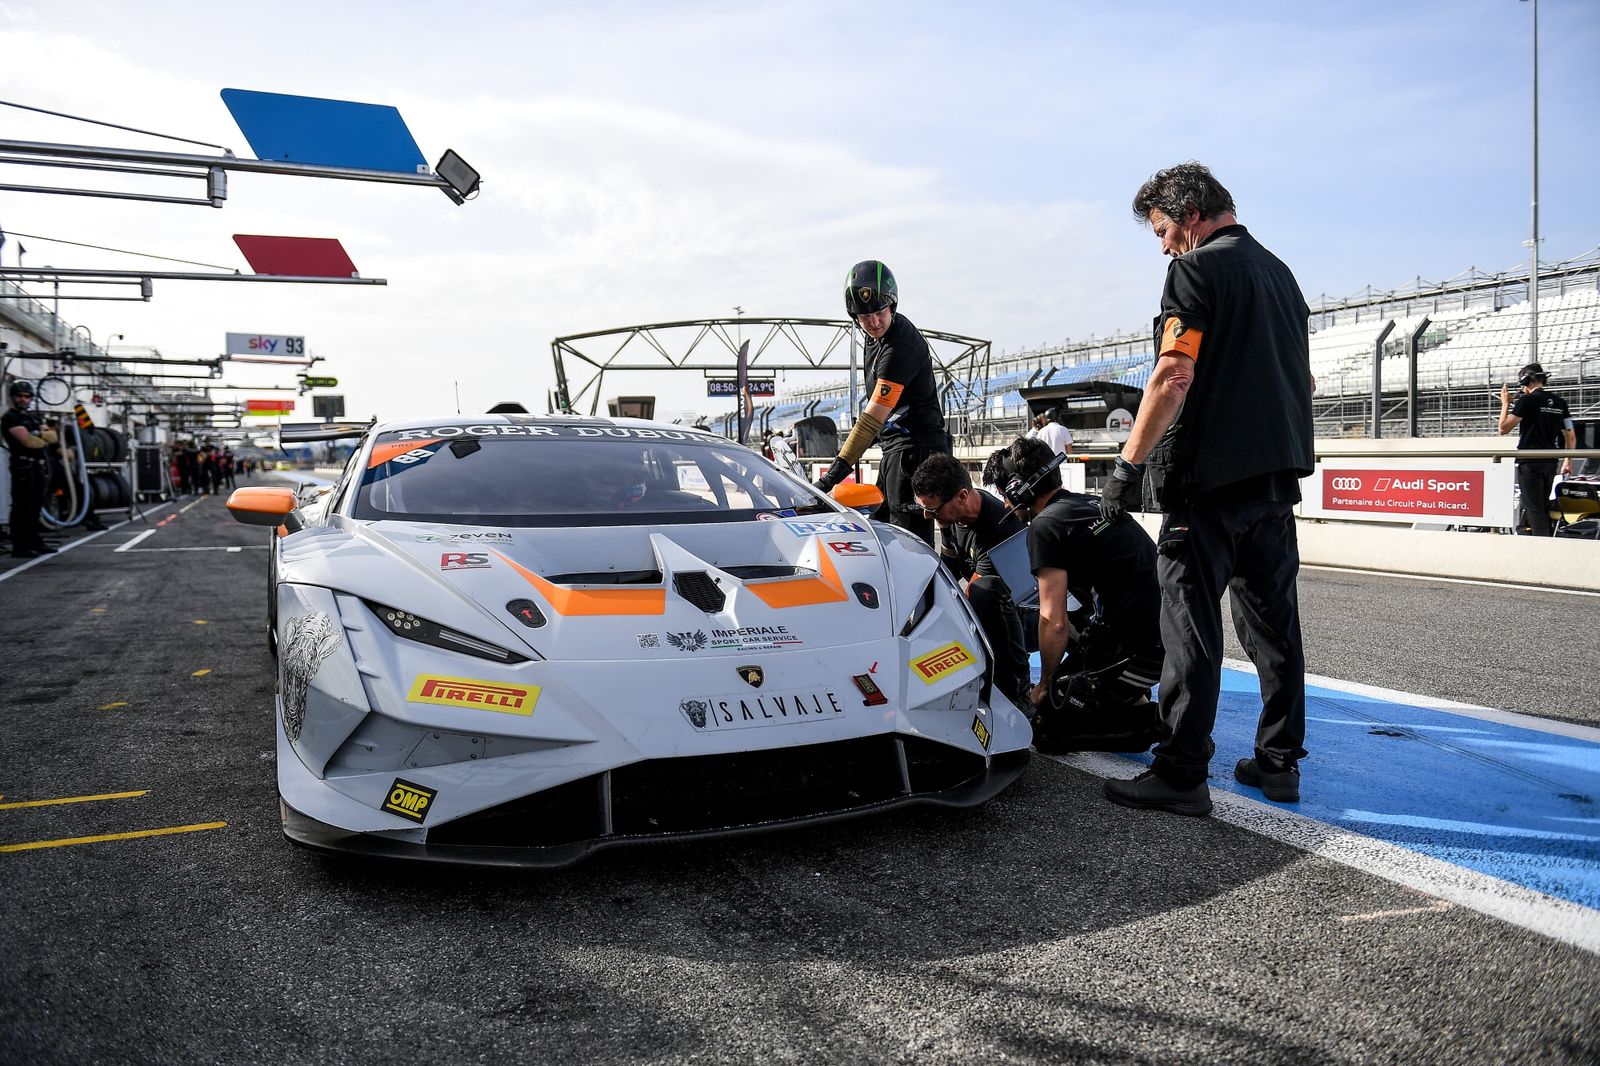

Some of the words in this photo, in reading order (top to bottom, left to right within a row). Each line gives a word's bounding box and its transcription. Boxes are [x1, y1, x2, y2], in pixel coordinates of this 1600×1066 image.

[248, 334, 278, 352] sky
[286, 337, 304, 354] 93
[399, 425, 560, 440] ROGER
[572, 427, 725, 445] DUBUIS
[391, 448, 435, 464] 89
[1392, 478, 1424, 490] Audi
[1427, 478, 1470, 493] Sport
[1332, 497, 1373, 506] Partenaire
[1375, 498, 1385, 507] du
[1387, 499, 1415, 508] Circuit
[1416, 500, 1436, 509] Paul
[1438, 501, 1470, 510] Ricard.
[828, 541, 869, 553] RS
[441, 552, 489, 566] RS
[711, 625, 788, 637] IMPERIALE
[711, 638, 740, 646] SPORT
[762, 634, 798, 642] SERVICE
[915, 646, 969, 678] PIRELLI
[420, 679, 528, 708] PIRELLI
[718, 692, 843, 722] SALVAJE
[390, 788, 428, 812] OMP
